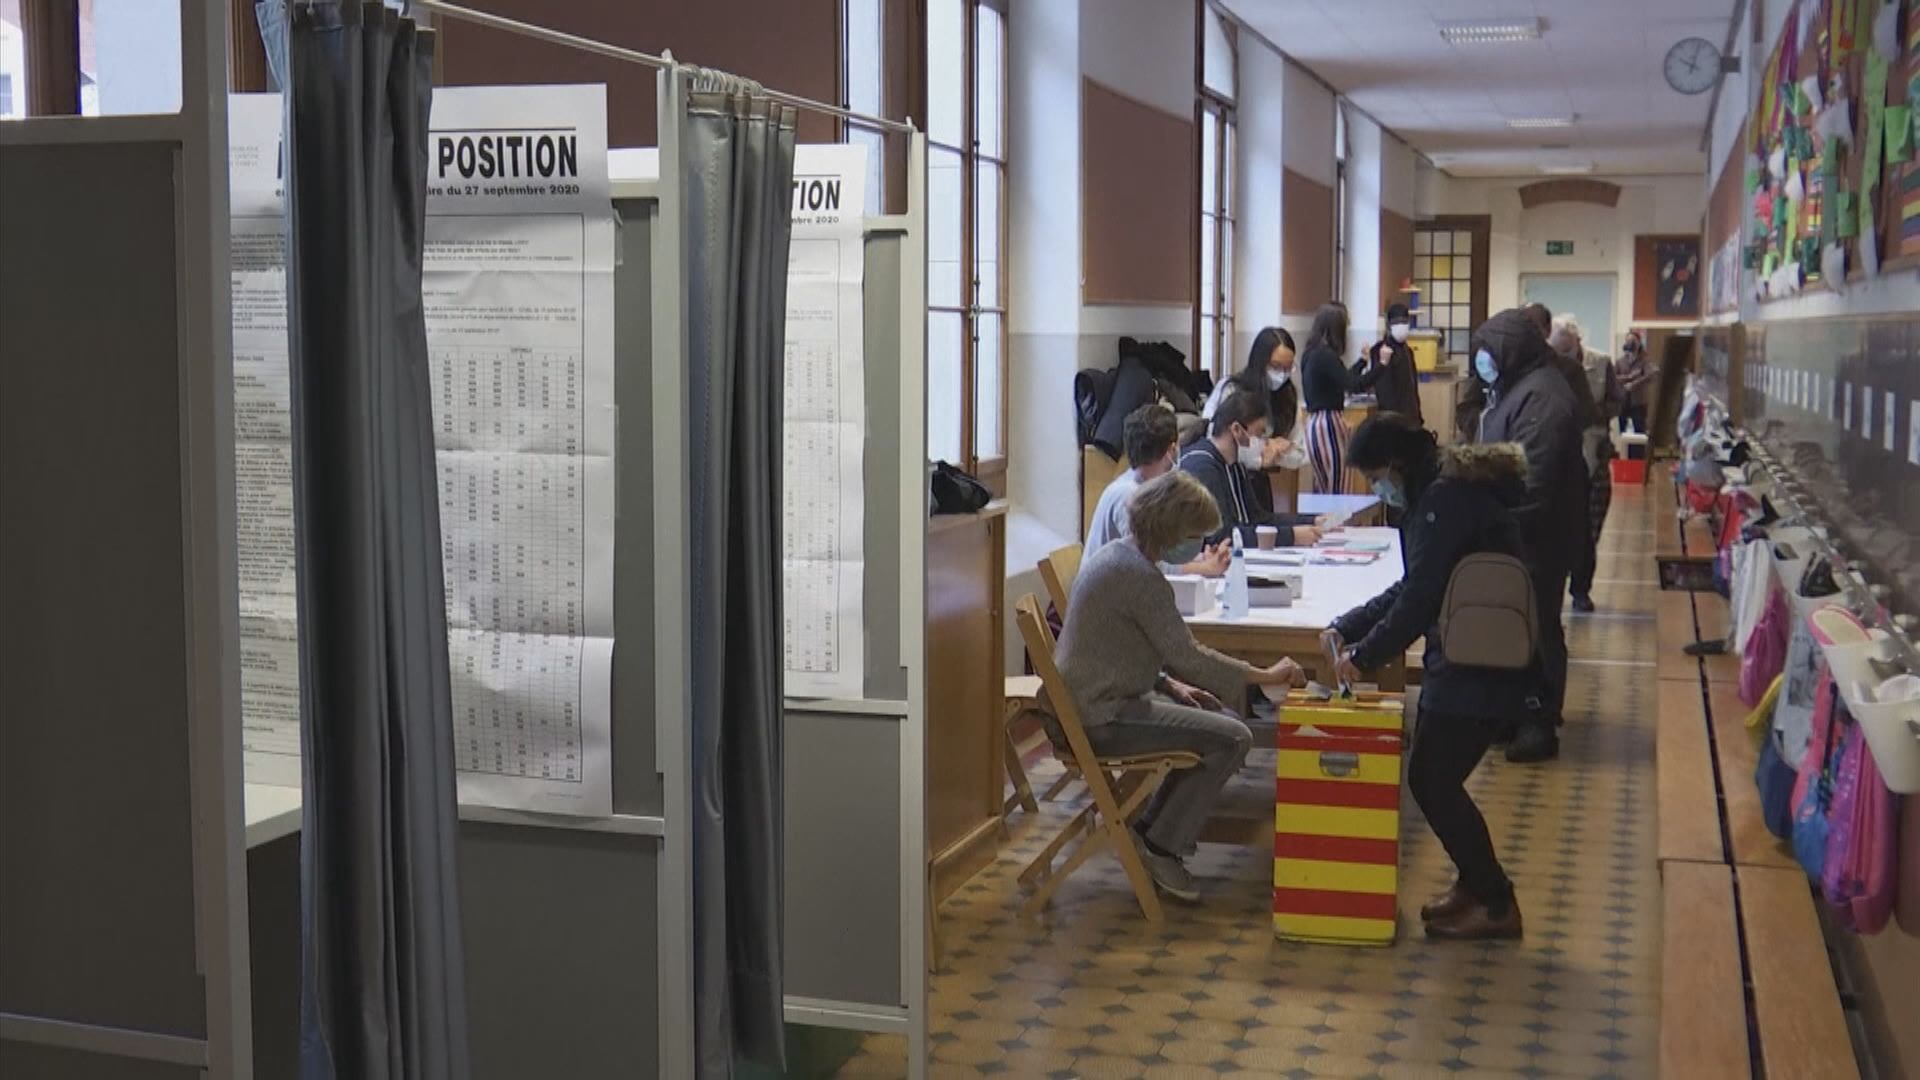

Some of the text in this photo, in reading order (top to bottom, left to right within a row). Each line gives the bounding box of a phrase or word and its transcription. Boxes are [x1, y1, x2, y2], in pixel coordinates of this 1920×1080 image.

[438, 135, 577, 178] POSITION
[447, 185, 461, 195] du
[465, 186, 479, 195] 27
[483, 185, 546, 197] septembre
[550, 184, 580, 195] 2020
